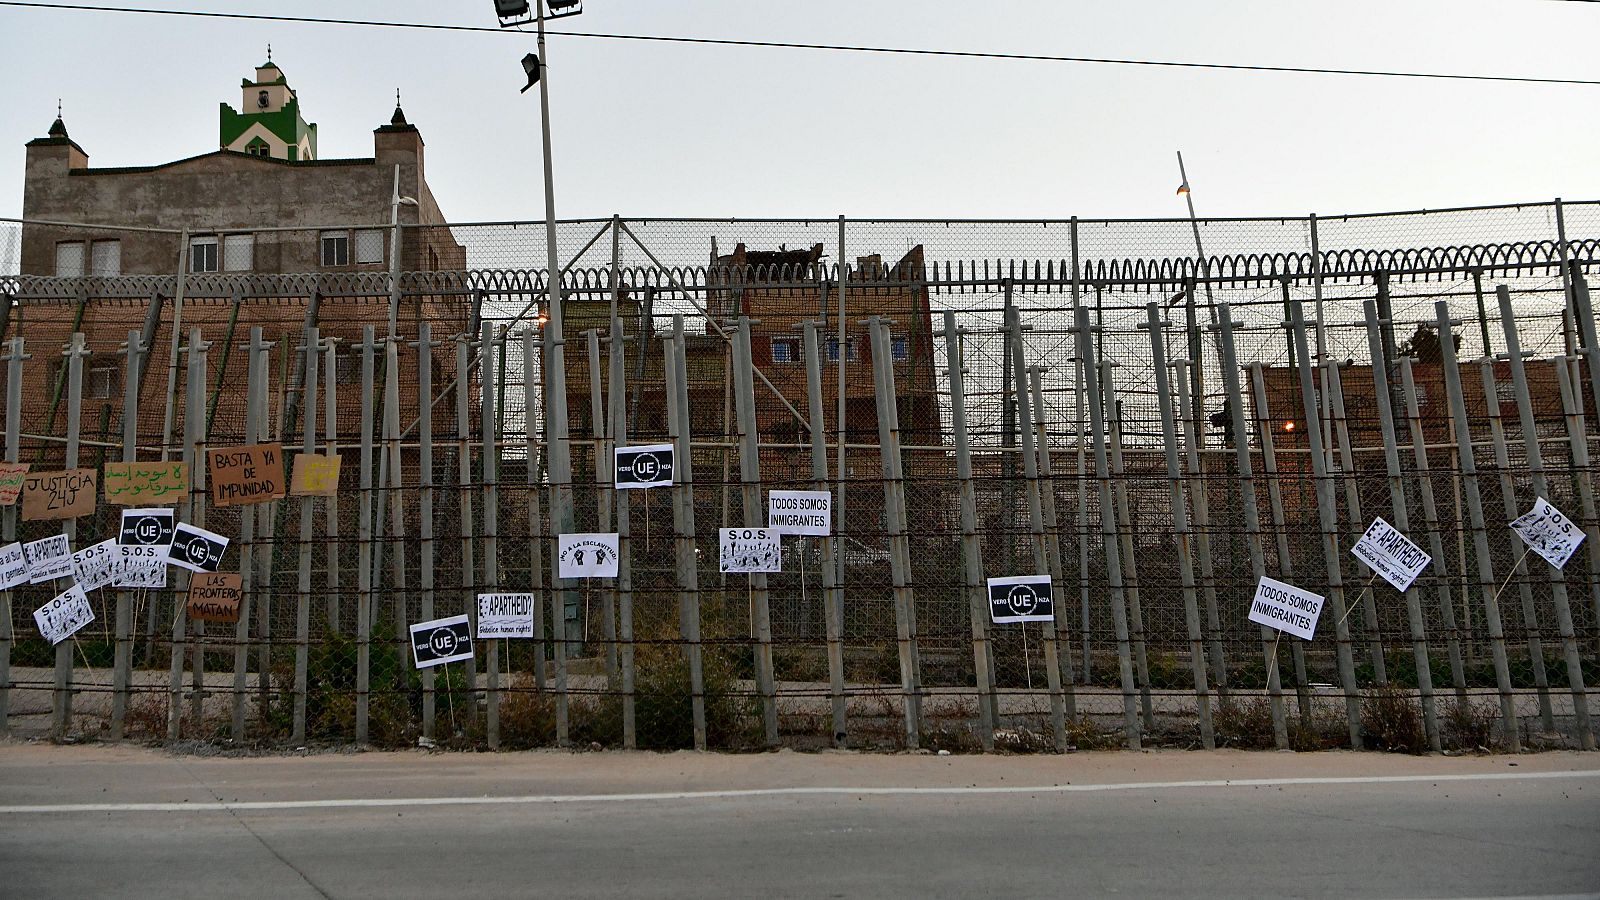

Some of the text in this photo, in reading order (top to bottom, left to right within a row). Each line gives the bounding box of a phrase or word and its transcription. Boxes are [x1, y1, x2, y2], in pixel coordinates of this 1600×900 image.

[215, 450, 275, 469] BASTA YA
[243, 467, 257, 479] DE
[637, 462, 655, 474] UE
[218, 480, 275, 500] IMPUNIDAD
[47, 489, 80, 511] 24J
[771, 498, 828, 511] TODOS SOMOS
[770, 514, 827, 528] INMIGRANTES.
[1543, 504, 1573, 537] S.O.S.
[140, 525, 157, 537] UE
[728, 529, 771, 541] S.O.S.
[73, 544, 109, 564] S.O.S.
[121, 546, 158, 558] S.O.S.
[190, 544, 206, 560] UE
[1376, 528, 1427, 573] APARTHEID?
[206, 575, 227, 587] LAS
[41, 591, 76, 617] S.O.S.
[488, 595, 532, 616] APARTHEID?
[1013, 594, 1032, 607] UE
[1259, 584, 1319, 614] TODOS SOMOS
[192, 601, 234, 617] MATAN
[1253, 600, 1311, 631] INMIGRANTES.
[434, 635, 453, 649] UE
